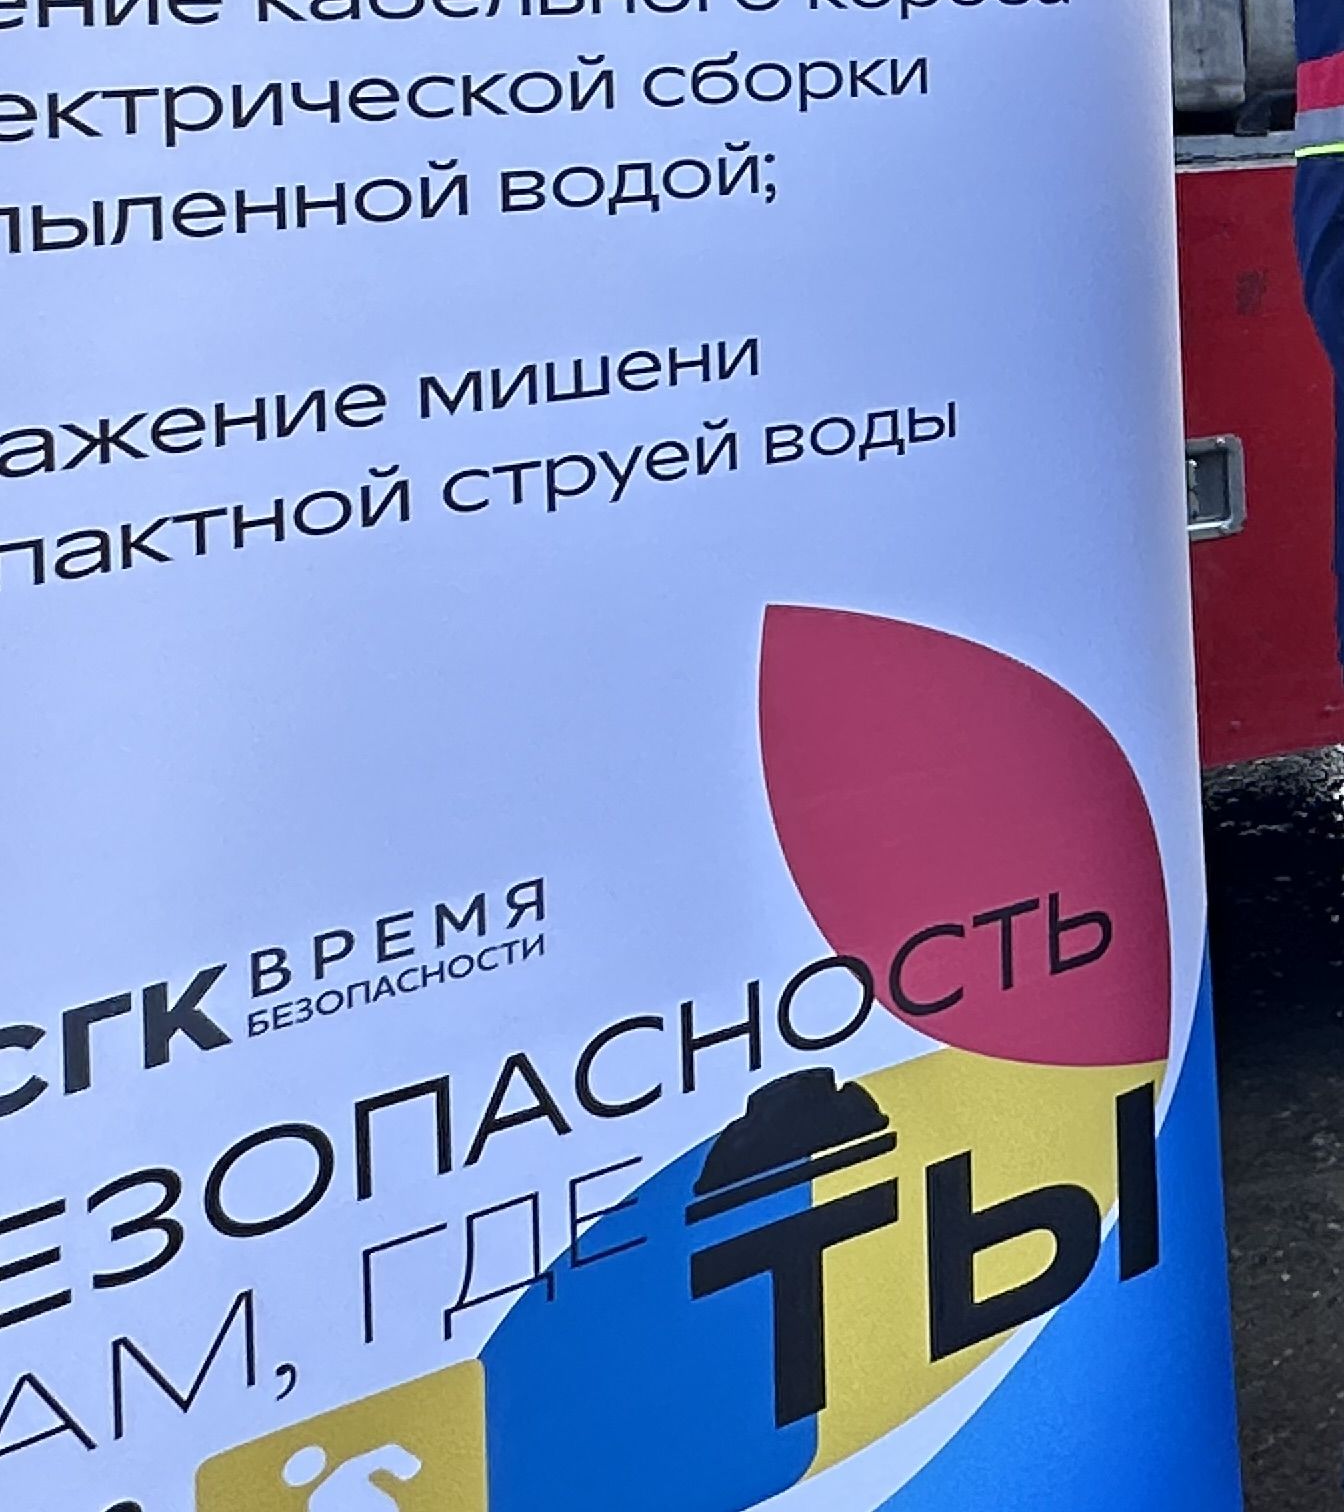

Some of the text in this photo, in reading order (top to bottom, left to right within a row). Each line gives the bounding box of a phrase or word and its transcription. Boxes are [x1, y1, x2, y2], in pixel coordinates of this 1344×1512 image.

[0, 50, 929, 148] ектрической сборки
[500, 140, 777, 216] водой;
[0, 338, 759, 478] ажение мишени
[442, 417, 738, 514] струей
[764, 401, 957, 466] воды
[247, 933, 546, 1038] БЕЗОПАСНОСТИ
[250, 877, 546, 1000] ВРЕМЯ
[362, 1156, 648, 1343] ГДЕ
[691, 1081, 1159, 1427] ТЫ
